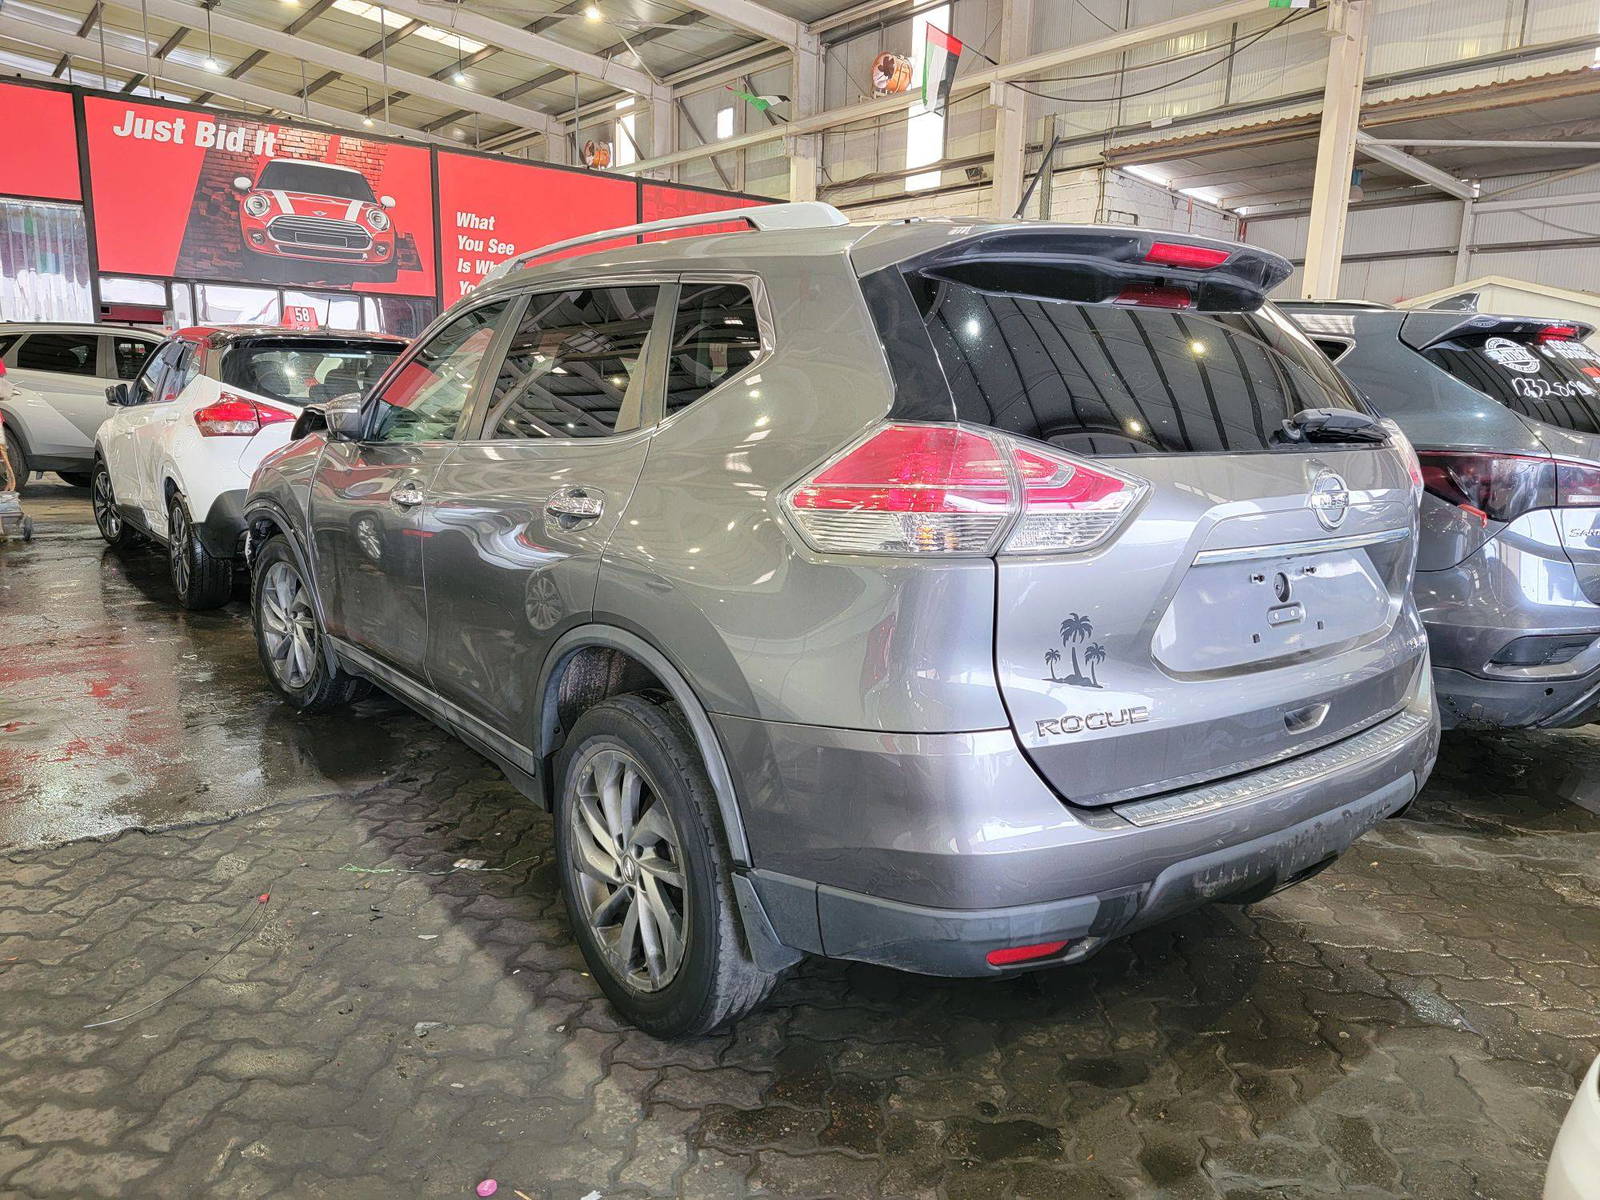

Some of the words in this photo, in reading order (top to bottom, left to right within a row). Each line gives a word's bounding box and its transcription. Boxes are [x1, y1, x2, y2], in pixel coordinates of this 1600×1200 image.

[113, 110, 186, 145] Just
[195, 121, 246, 153] Bid
[254, 129, 277, 158] It
[456, 211, 495, 231] What
[457, 234, 484, 253] You
[488, 238, 515, 256] See
[457, 258, 472, 273] Is
[294, 307, 311, 322] 58
[1036, 706, 1149, 737] ROGUE
